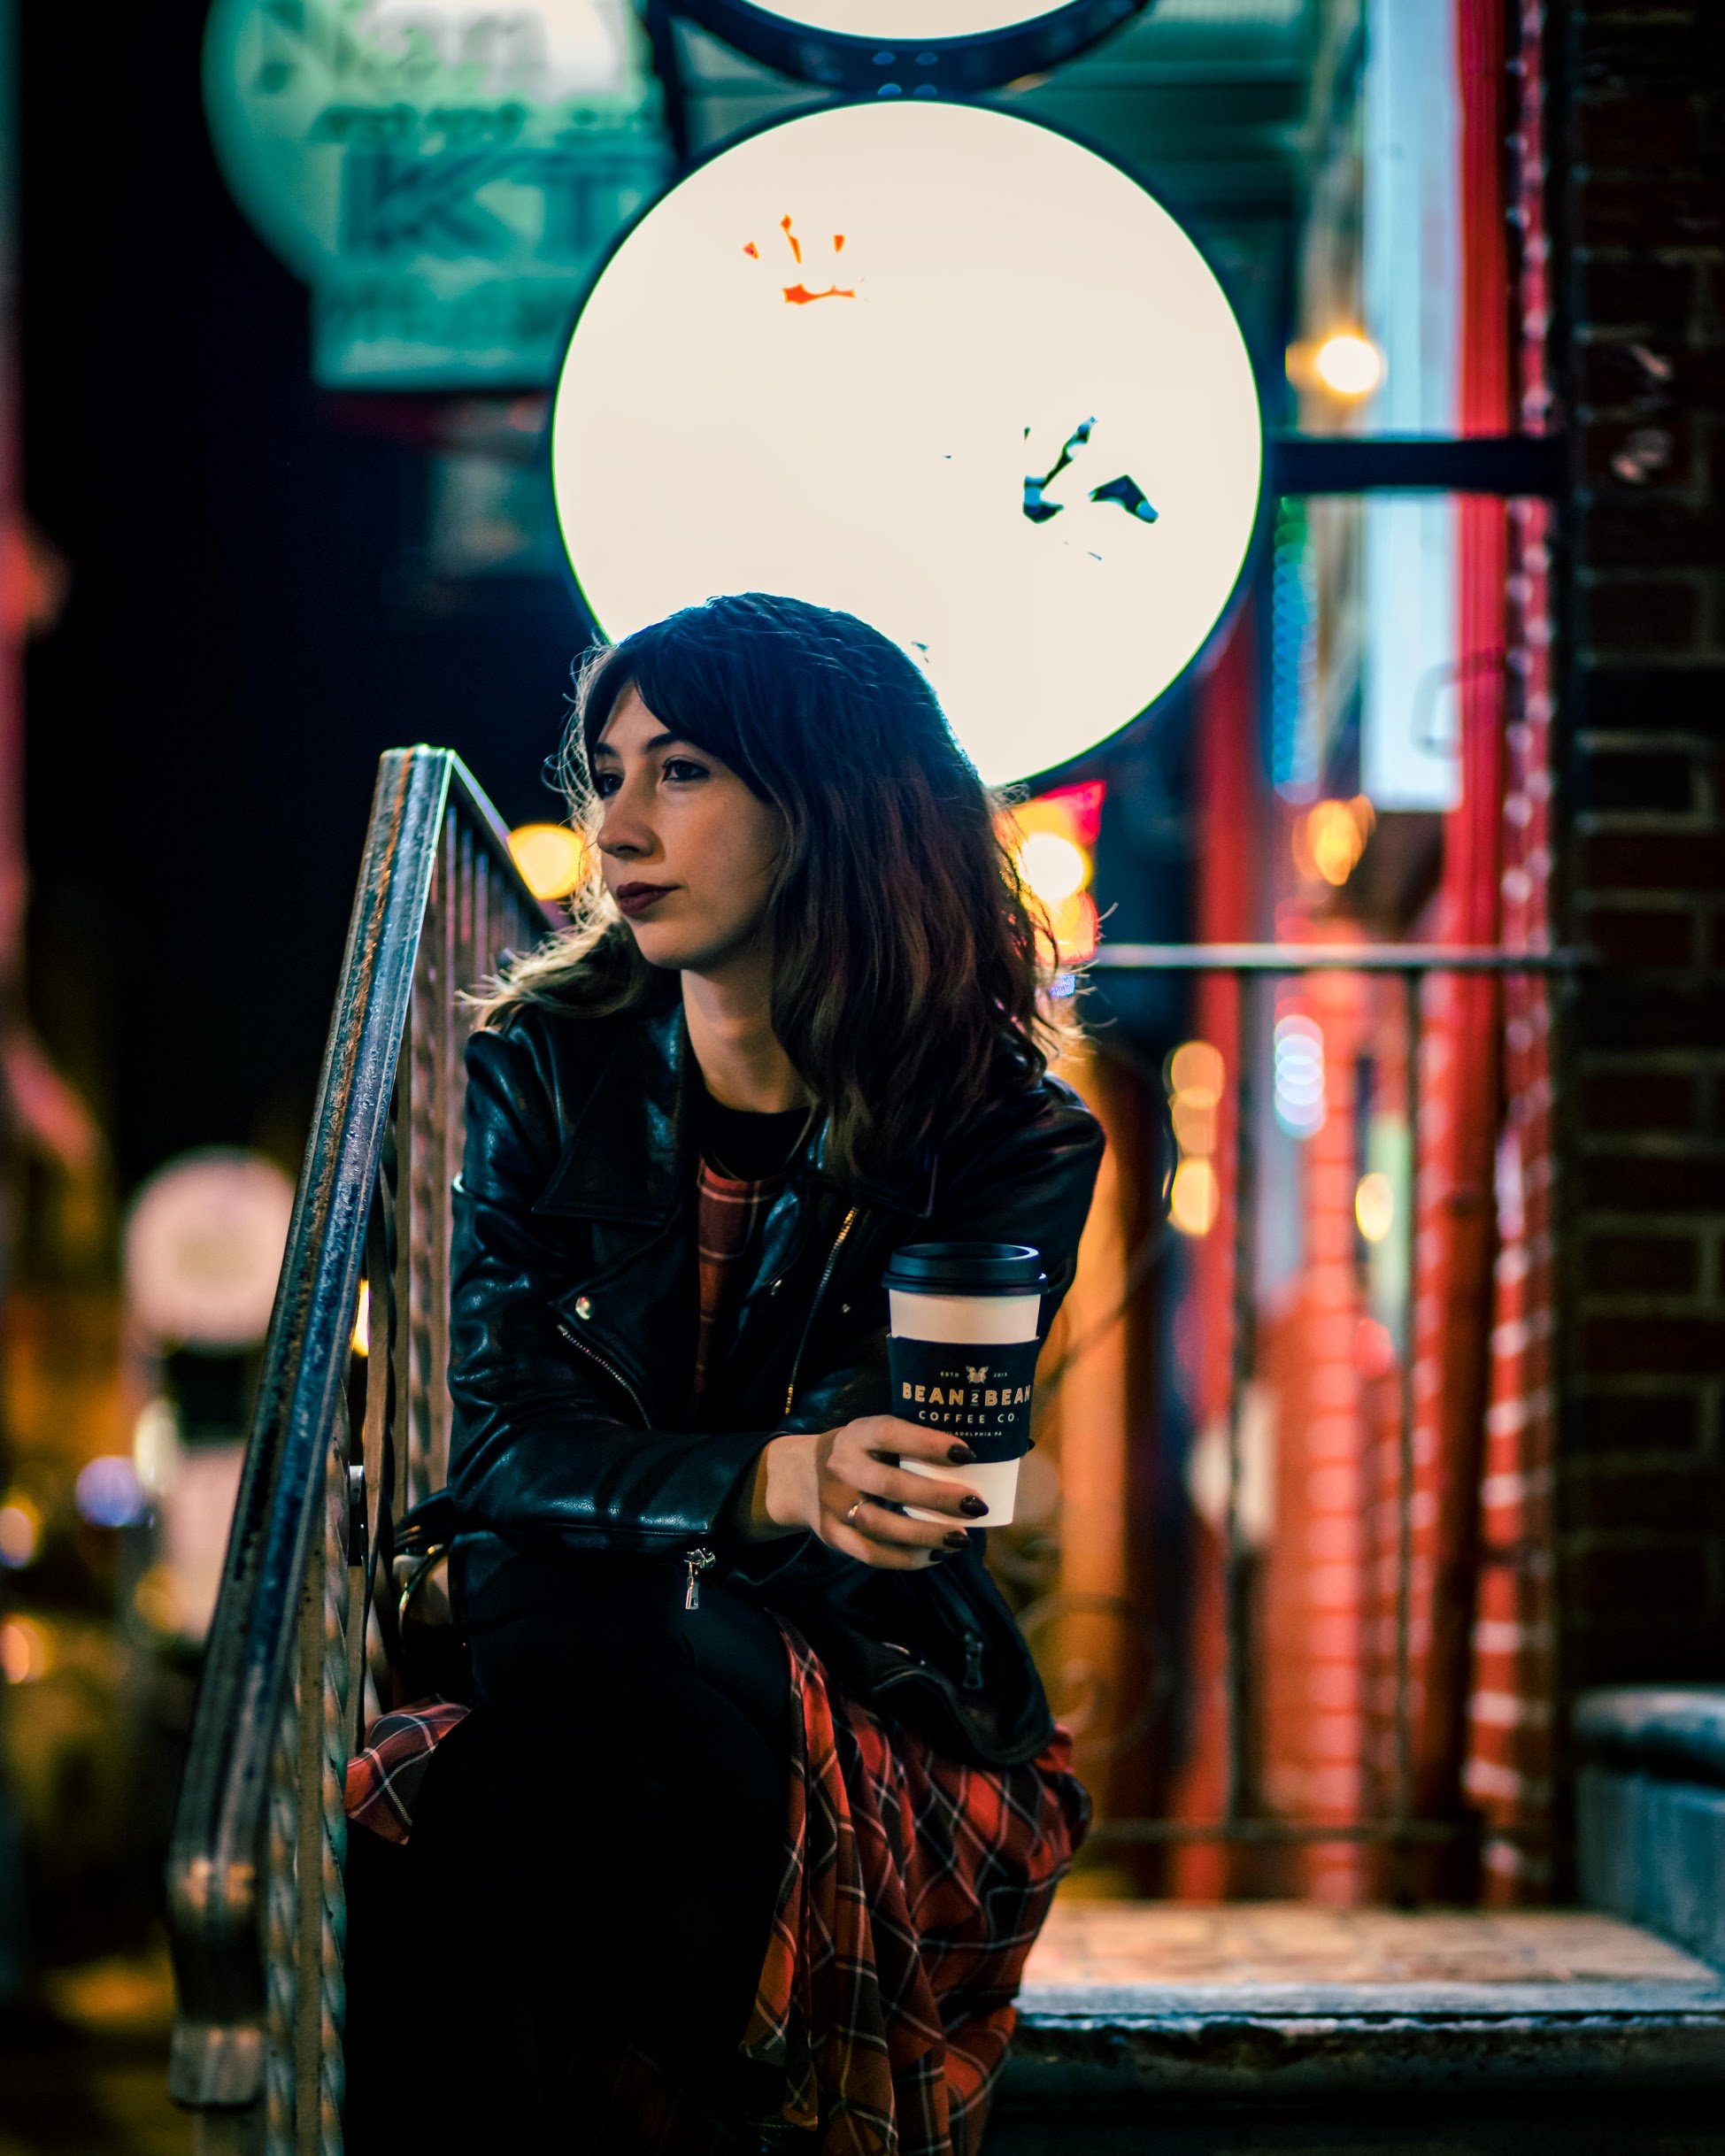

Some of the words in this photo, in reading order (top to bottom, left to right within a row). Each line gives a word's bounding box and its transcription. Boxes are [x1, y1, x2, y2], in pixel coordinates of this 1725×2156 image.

[902, 1382, 965, 1405] BEAN
[971, 1392, 979, 1404] 2
[984, 1384, 1031, 1406] BEAN
[919, 1410, 986, 1424] COFFEE
